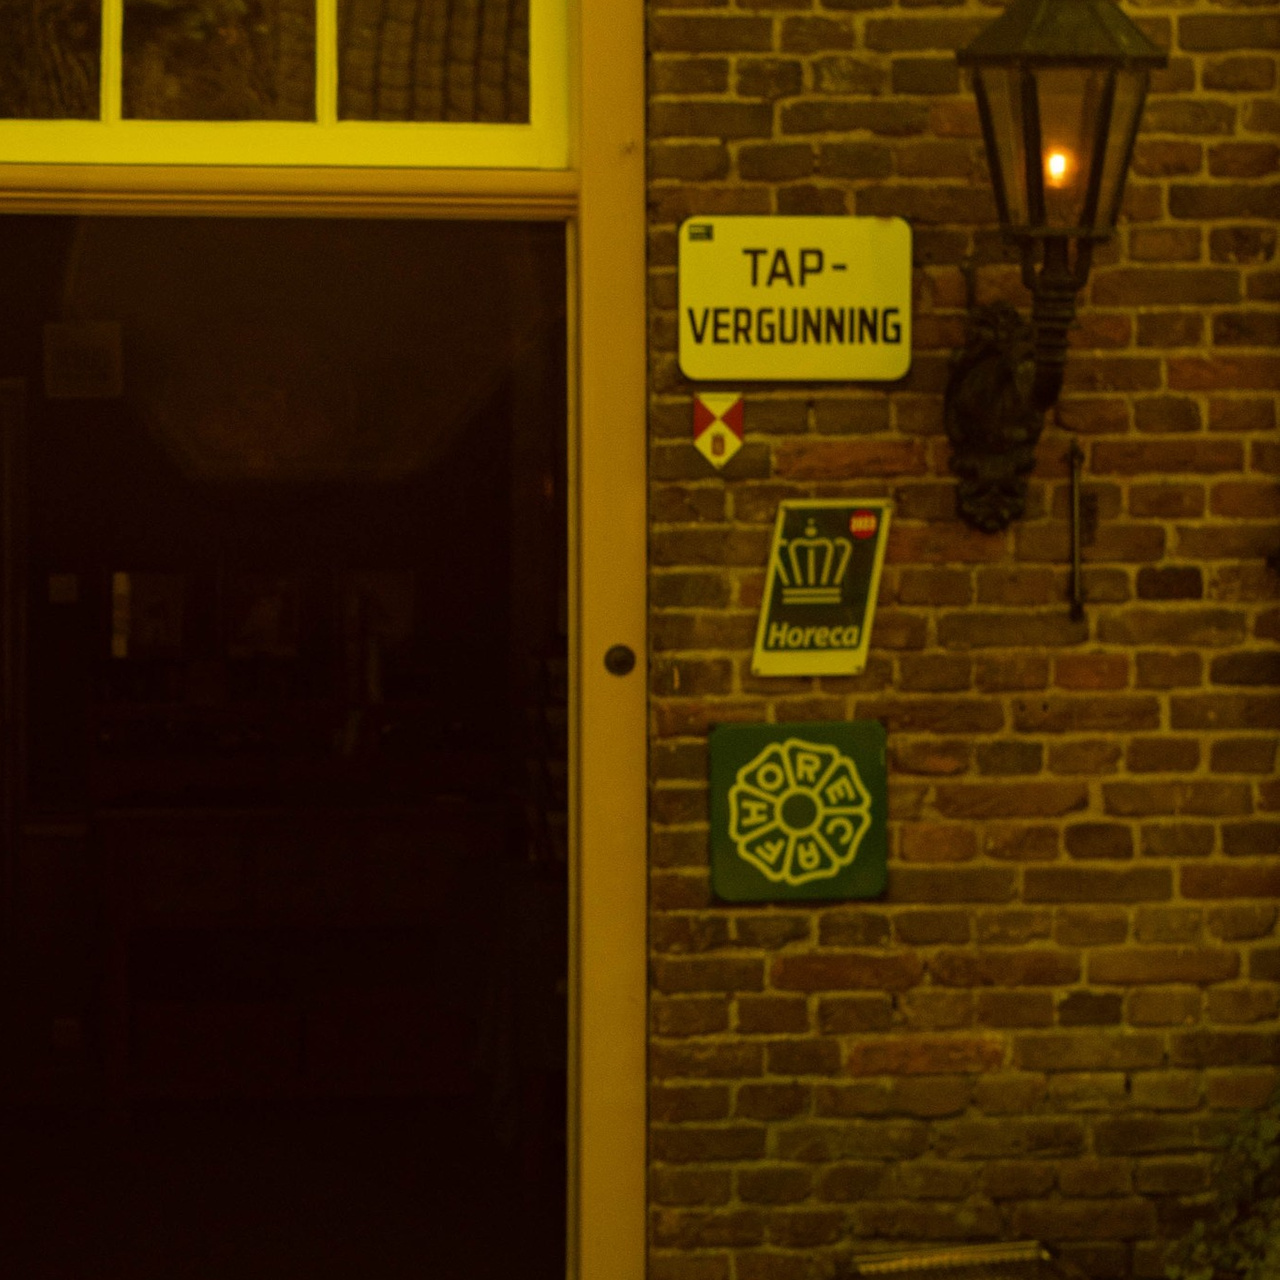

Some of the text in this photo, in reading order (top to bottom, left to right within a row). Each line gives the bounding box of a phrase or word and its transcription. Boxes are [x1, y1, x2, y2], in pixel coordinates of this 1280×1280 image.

[742, 247, 848, 288] TAP-
[687, 306, 903, 346] VERGUNNING
[766, 621, 861, 648] Horeca
